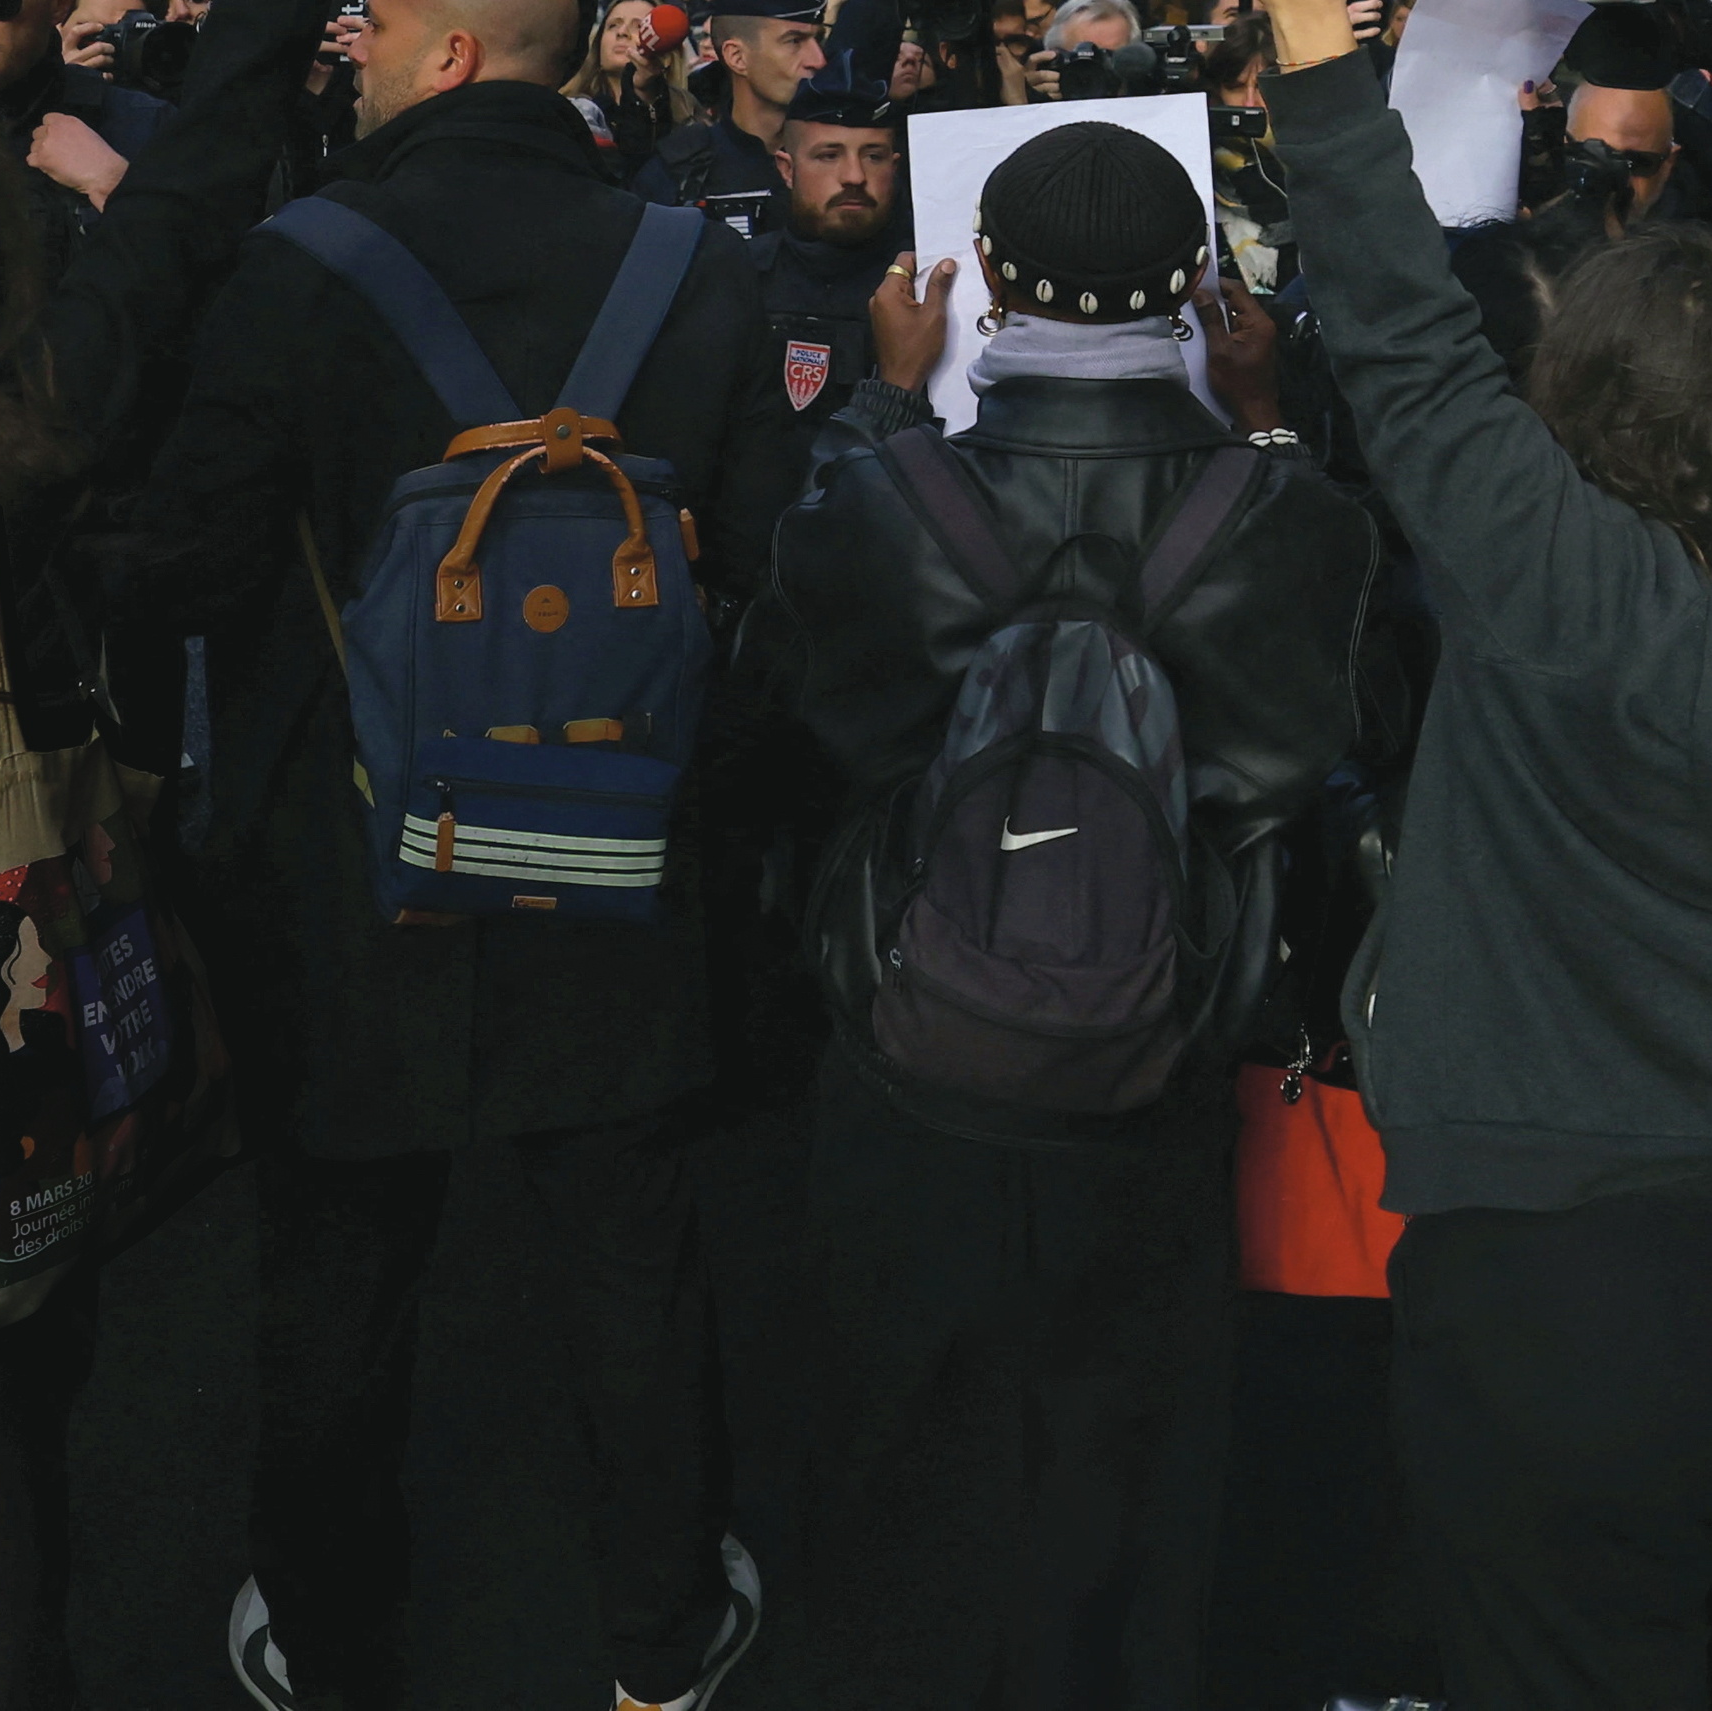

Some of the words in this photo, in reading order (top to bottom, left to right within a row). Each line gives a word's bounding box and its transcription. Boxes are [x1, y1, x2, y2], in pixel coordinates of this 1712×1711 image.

[639, 12, 660, 52] RTL
[789, 363, 823, 382] CRS
[796, 349, 821, 358] POLICE
[9, 1199, 22, 1217] 8
[25, 1179, 73, 1212] MARS
[76, 1169, 99, 1191] 20
[12, 1203, 76, 1240] Journée
[14, 1236, 42, 1257] des
[45, 1216, 84, 1245] droits
